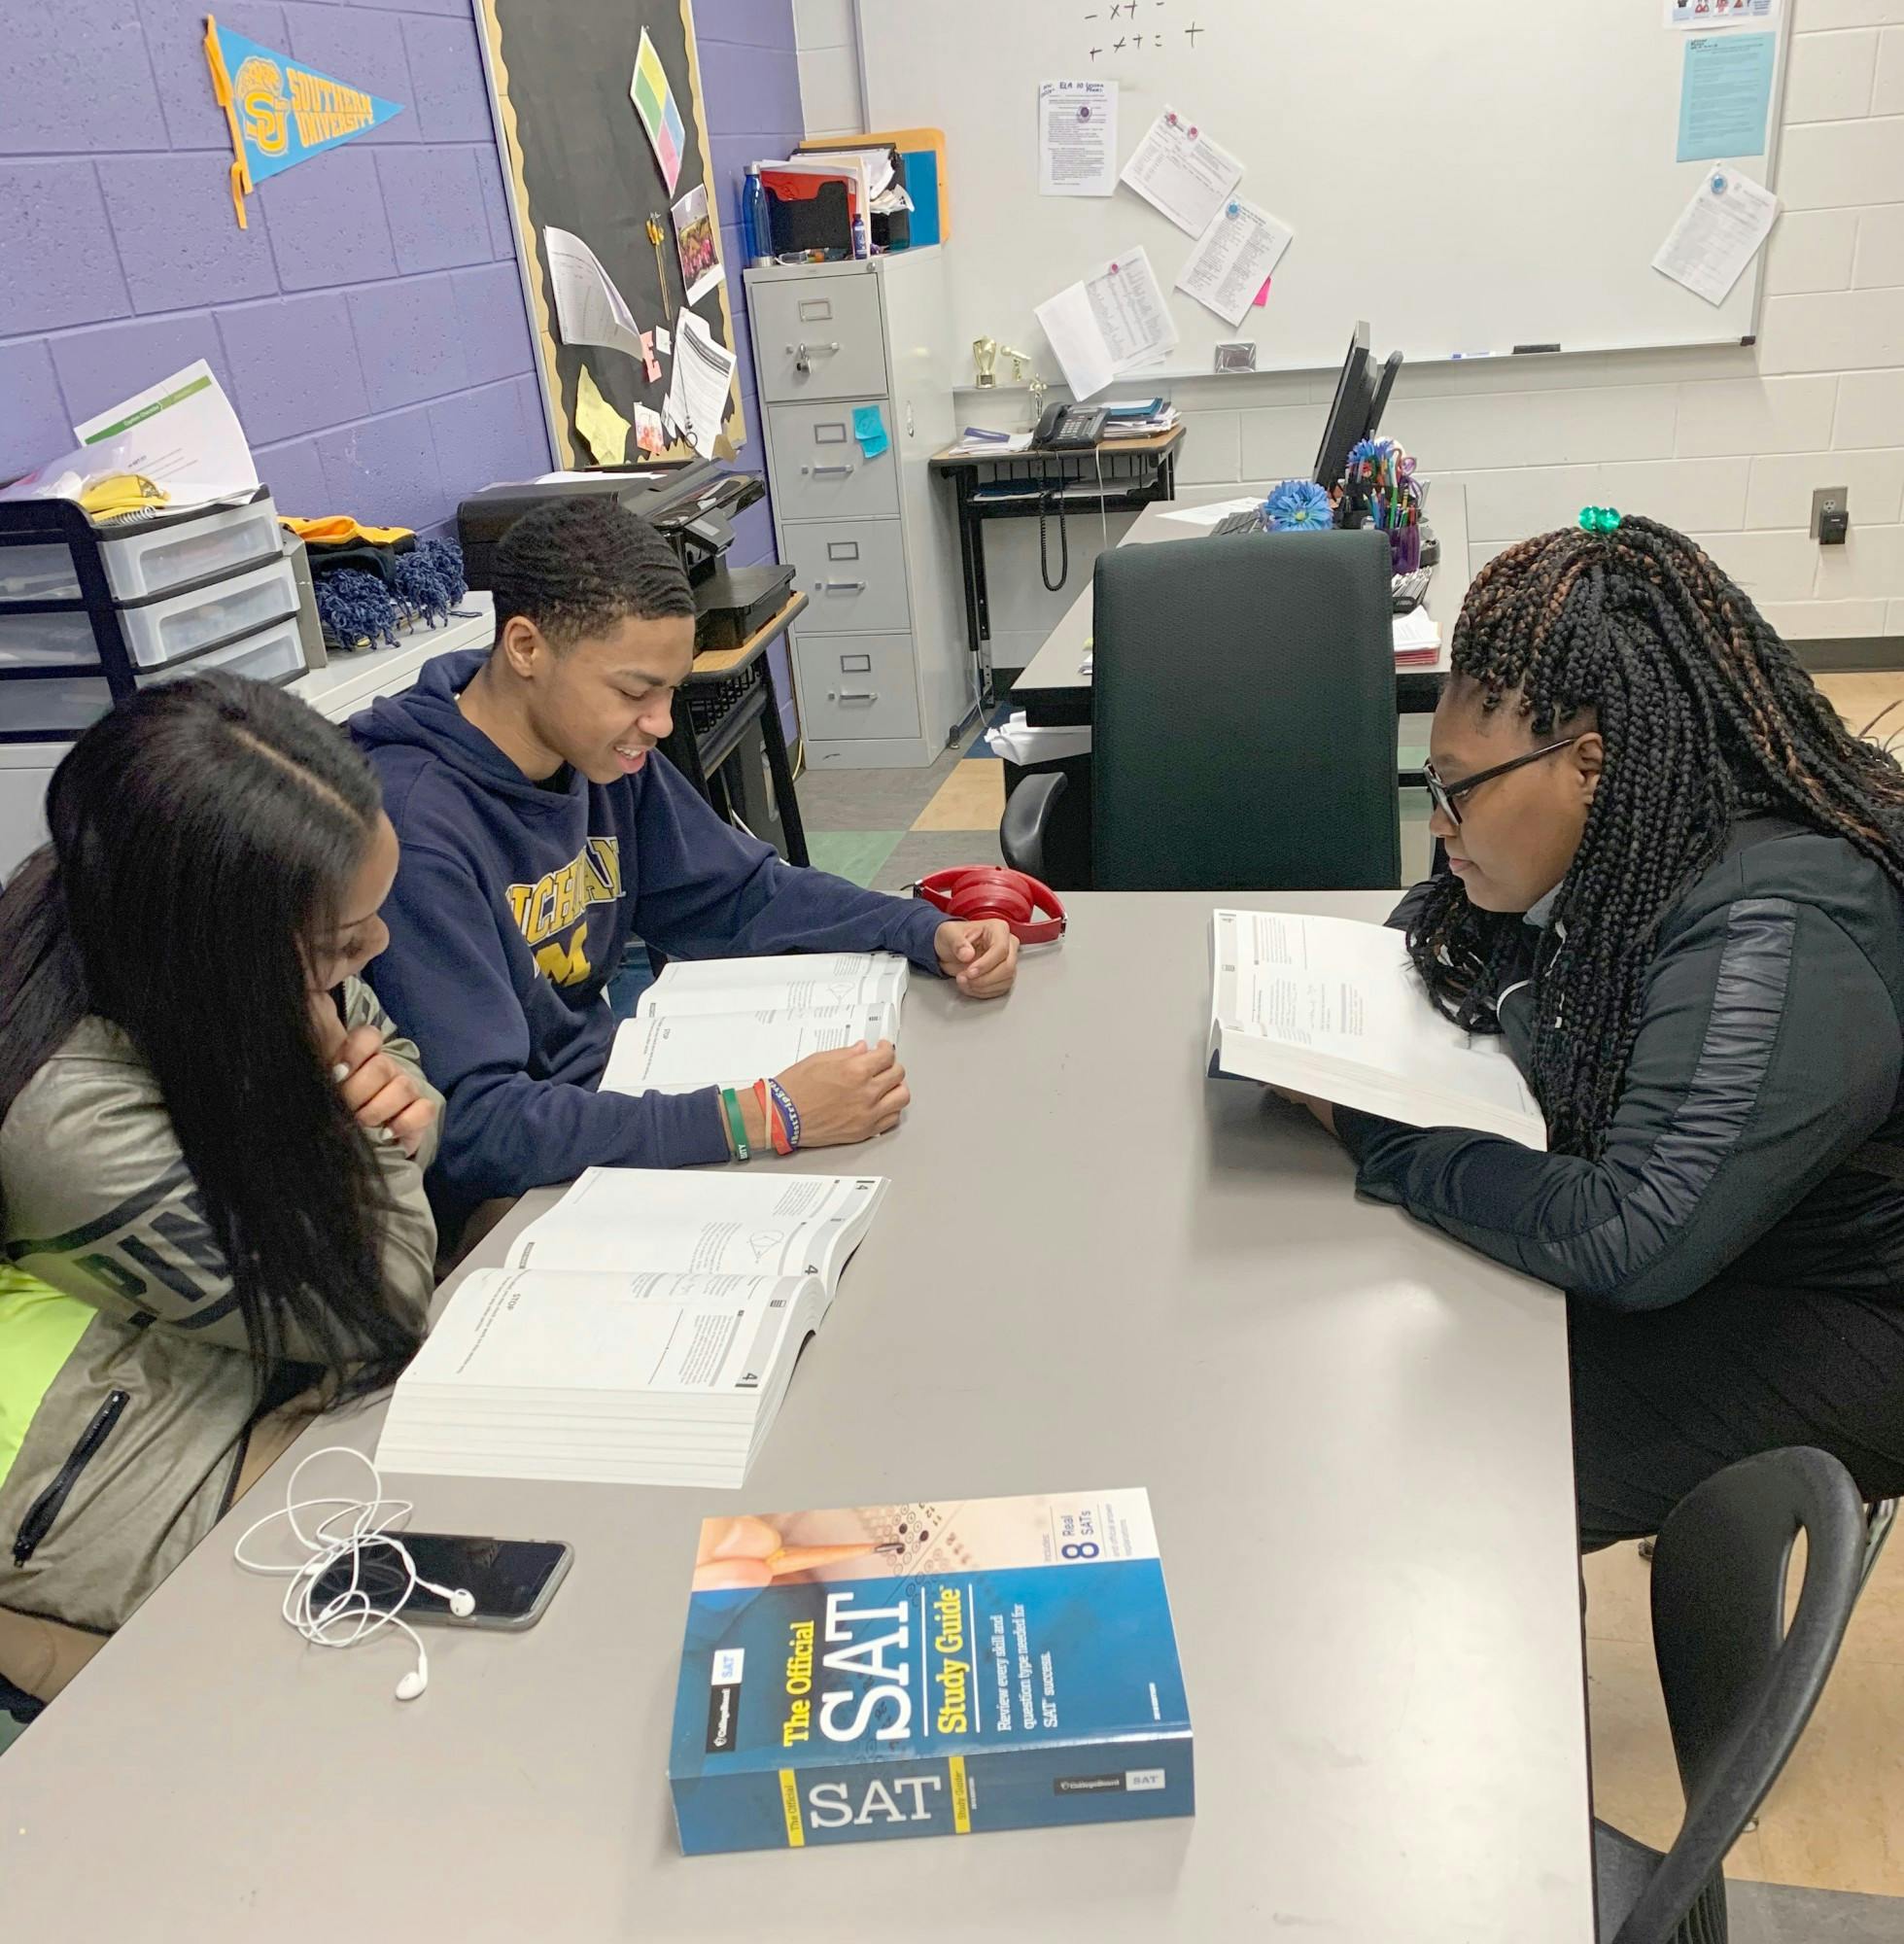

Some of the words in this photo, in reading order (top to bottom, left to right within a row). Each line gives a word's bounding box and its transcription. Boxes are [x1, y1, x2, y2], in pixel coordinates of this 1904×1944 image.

[286, 67, 372, 113] SOUTHERN
[245, 91, 288, 153] SU
[294, 108, 375, 148] UNIVERSITY
[805, 1264, 818, 1276] 4
[507, 1293, 521, 1310] STOP
[743, 1371, 758, 1381] 4
[1060, 1515, 1075, 1537] Real
[1079, 1510, 1094, 1536] SATs
[1061, 1542, 1099, 1560] 8
[989, 1614, 1005, 1635] and
[1011, 1603, 1024, 1618] for
[991, 1635, 1006, 1657] skill
[1012, 1617, 1028, 1654] needed
[721, 1655, 735, 1679] SAT
[786, 1620, 814, 1695] Official
[819, 1592, 912, 1742] SAT
[996, 1657, 1010, 1687] every
[1018, 1654, 1033, 1679] type
[1040, 1650, 1055, 1696] success.
[937, 1657, 970, 1734] Study
[996, 1687, 1012, 1731] Review
[1019, 1678, 1037, 1730] question
[783, 1699, 811, 1748] The
[1132, 1775, 1158, 1786] SAT
[784, 1785, 799, 1815] Official
[809, 1776, 941, 1828] SAT
[789, 1815, 800, 1832] The
